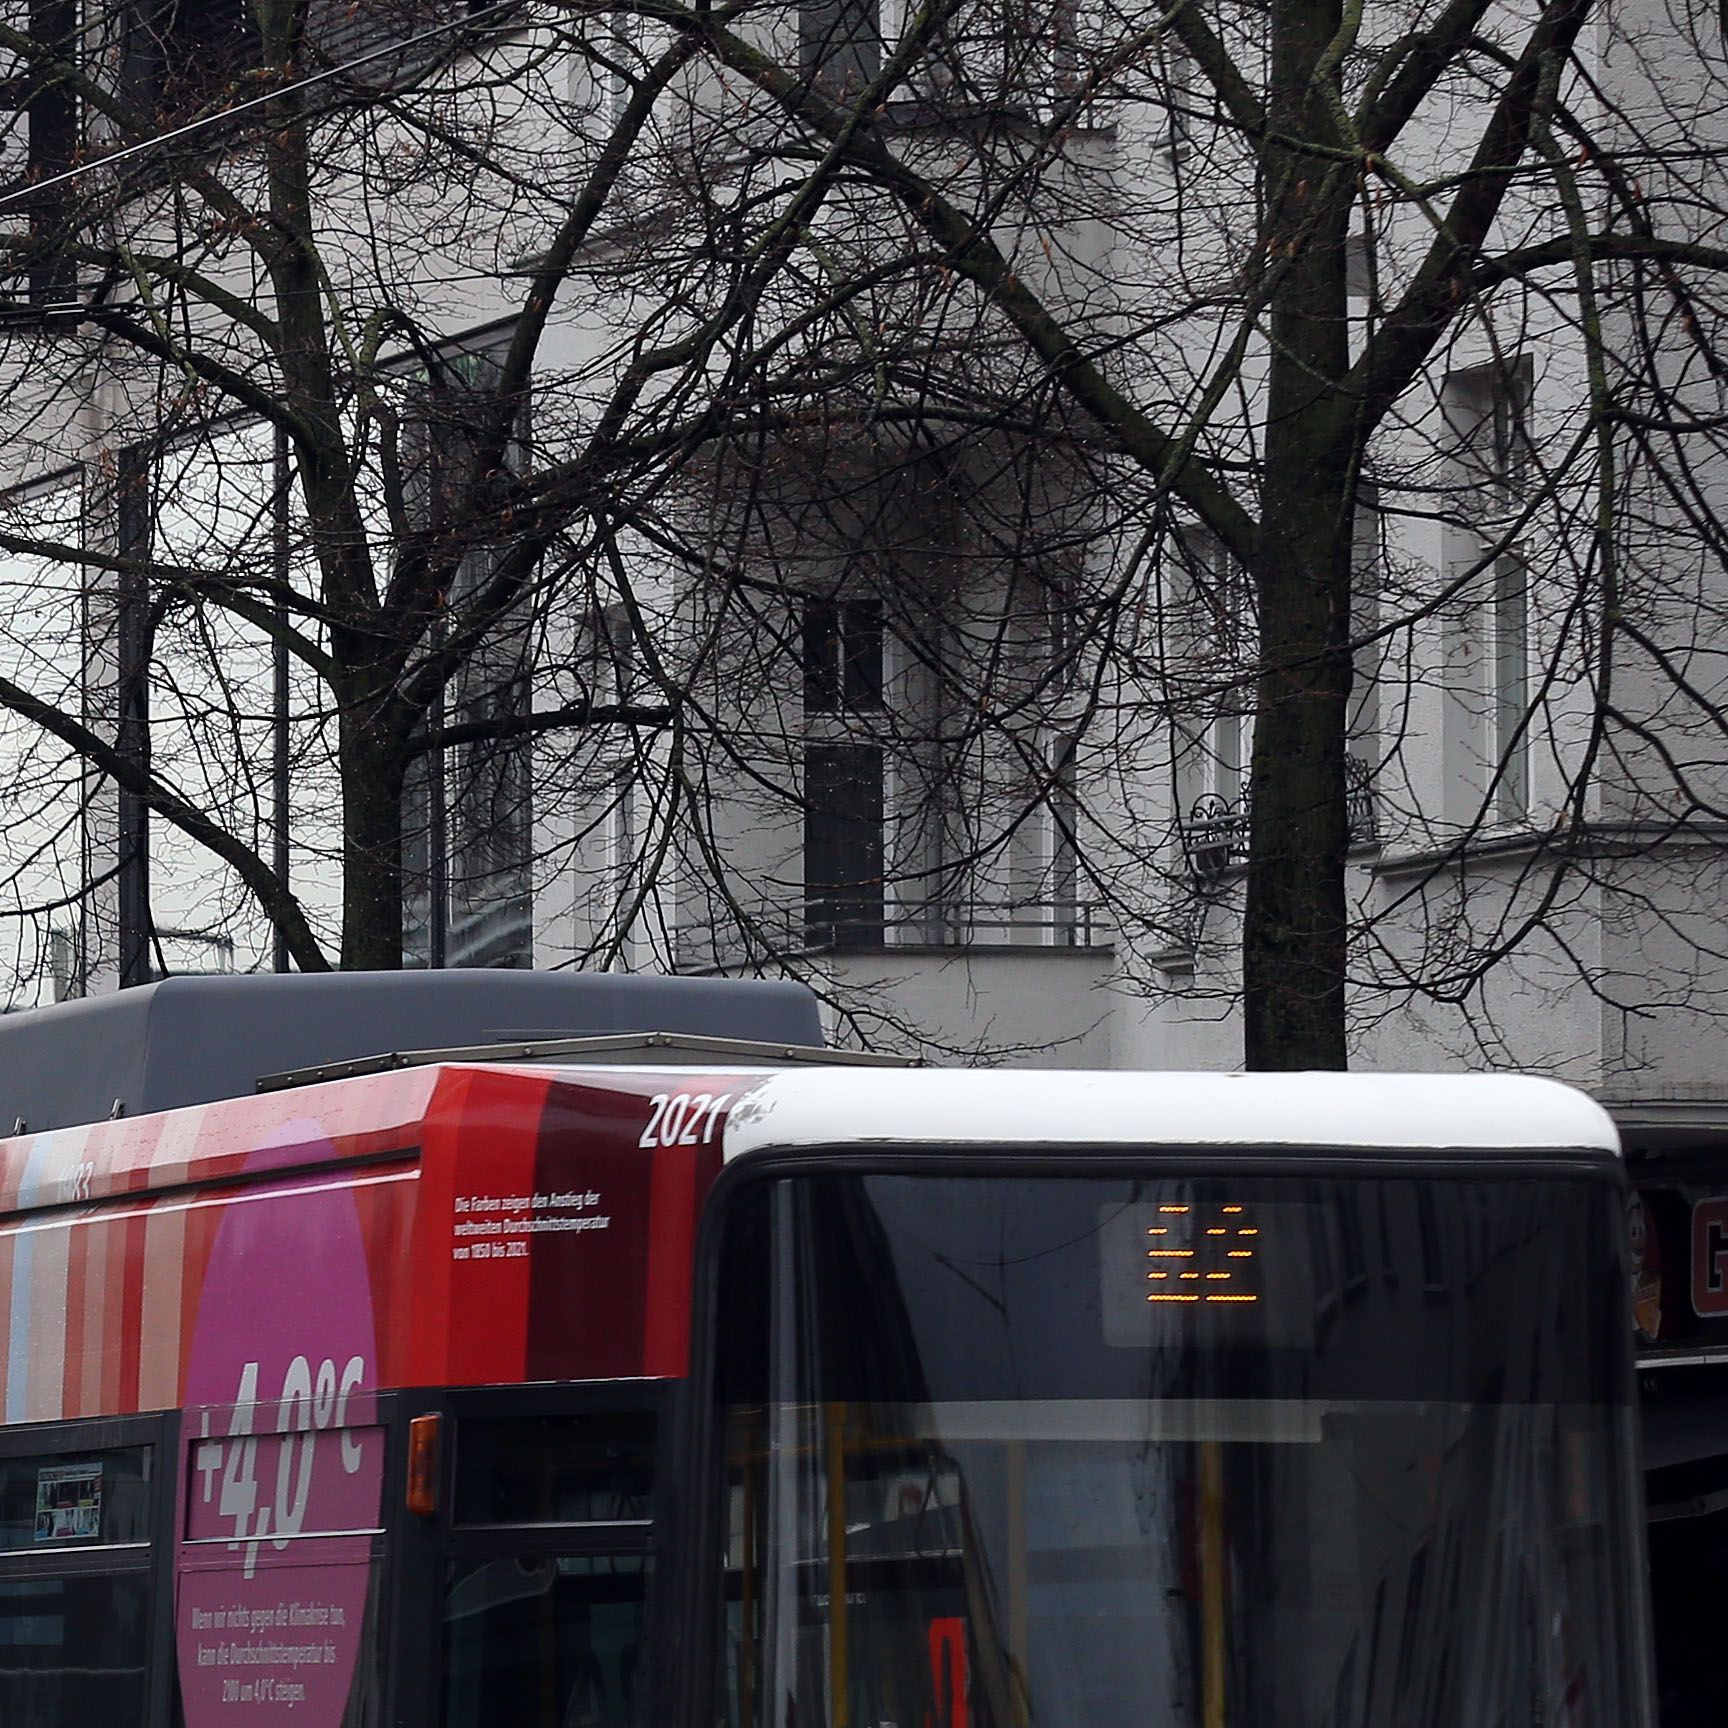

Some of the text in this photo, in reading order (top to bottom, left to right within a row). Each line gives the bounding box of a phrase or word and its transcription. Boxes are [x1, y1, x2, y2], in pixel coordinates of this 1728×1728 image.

[639, 1094, 731, 1148] 2021
[455, 1190, 600, 1213] Die Farben zeigen den Anstieg der
[454, 1216, 610, 1235] weltweiten Durchschnittstemperatur
[453, 1241, 529, 1259] von 1850 bis 2021.
[192, 1607, 212, 1629] Wenn
[214, 1604, 226, 1627] wir
[227, 1603, 250, 1627] nichts
[250, 1610, 274, 1633] gegen
[275, 1602, 287, 1626] die
[288, 1602, 328, 1626] Klimakrise
[197, 1639, 336, 1671] kann die Durchschnittstemperatur bis
[240, 1684, 252, 1701] um
[275, 1679, 305, 1708] steigen.
